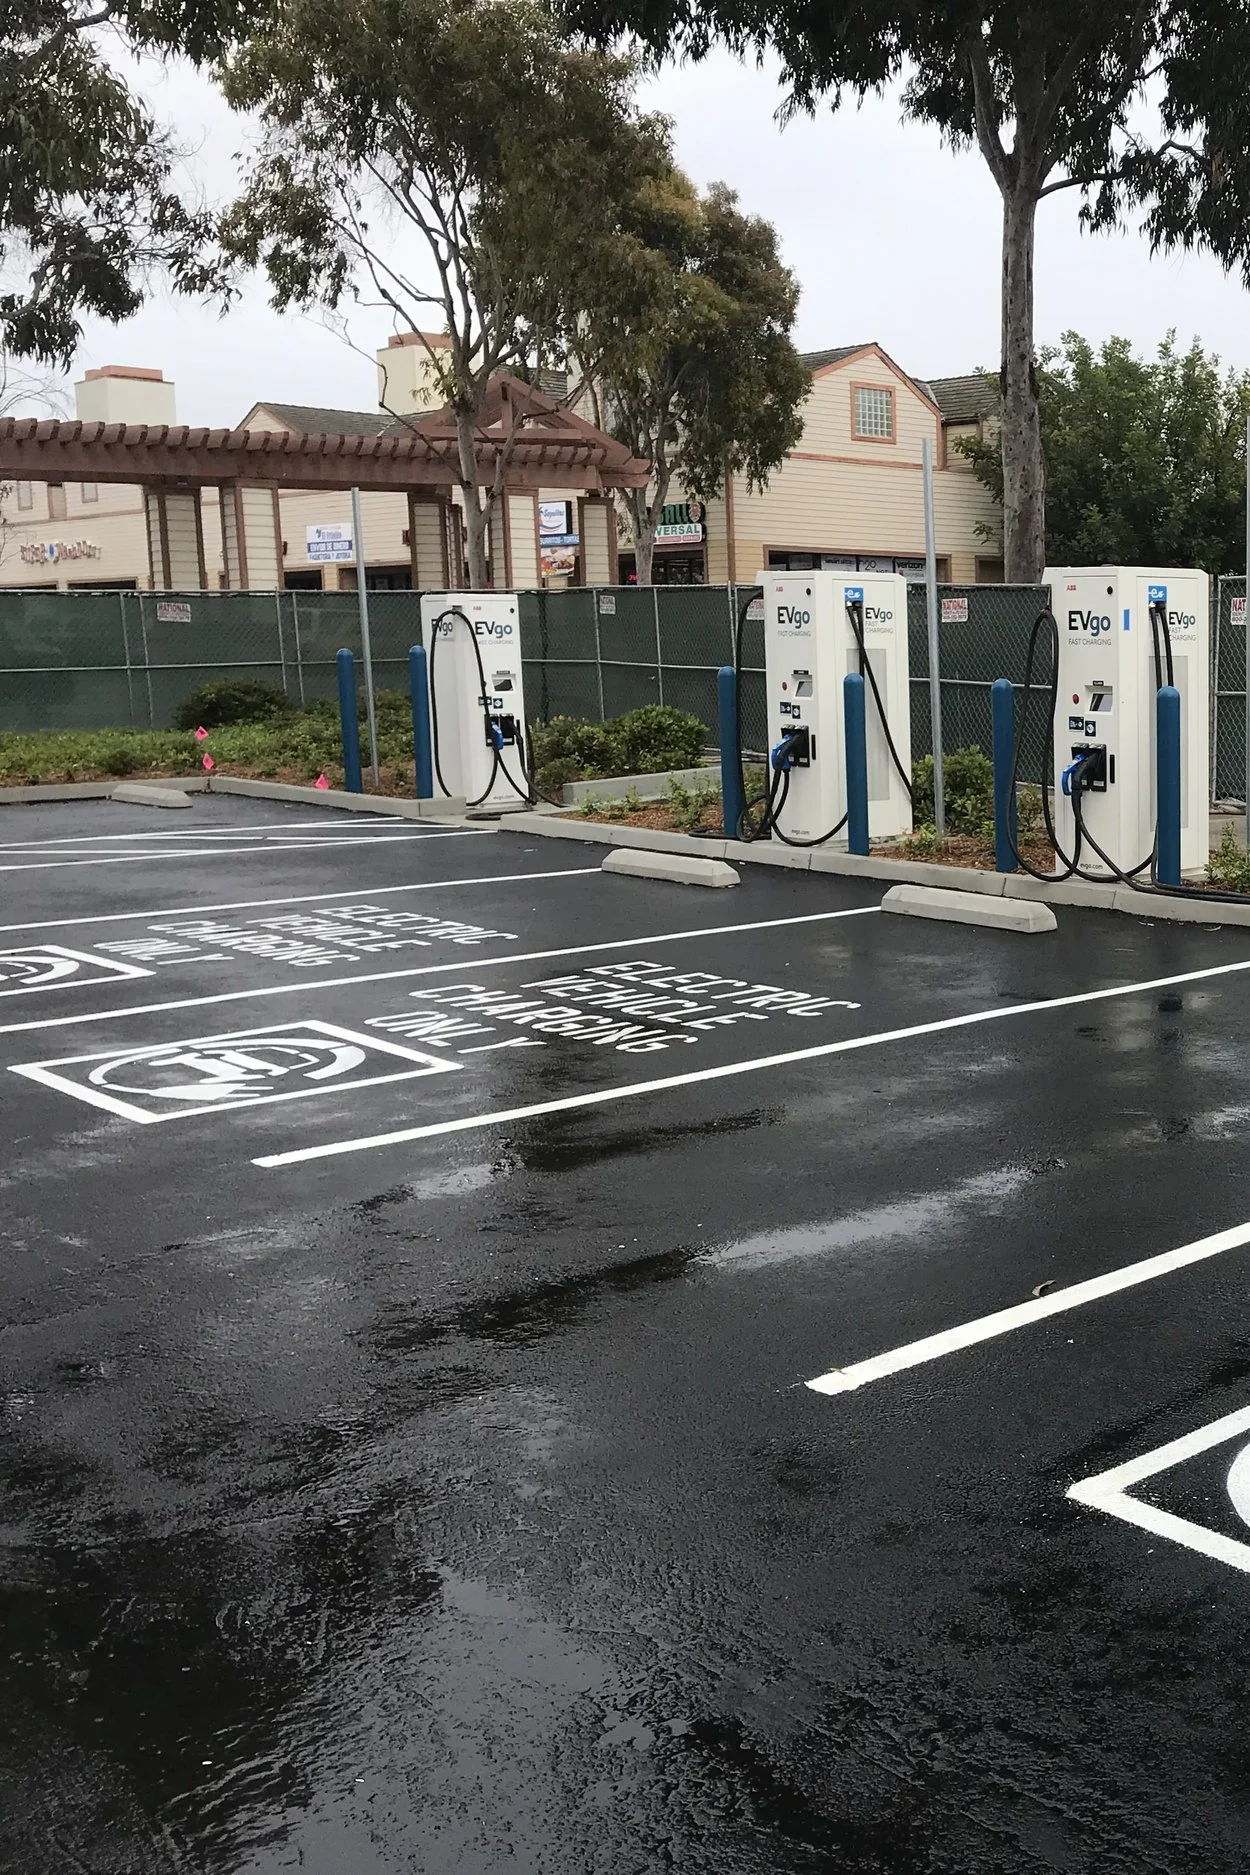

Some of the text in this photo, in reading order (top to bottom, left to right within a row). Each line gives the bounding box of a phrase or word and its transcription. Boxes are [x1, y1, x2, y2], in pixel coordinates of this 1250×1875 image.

[897, 560, 924, 569] verizon
[777, 606, 810, 629] EVgo
[865, 607, 893, 623] EVgo
[1068, 610, 1111, 637] EVgo
[1169, 612, 1196, 629] EVgo
[475, 621, 513, 639] EVgo
[1082, 638, 1112, 646] CHARGING
[246, 914, 432, 953] VEHICLE
[312, 904, 518, 945] ELECTRIC
[93, 938, 235, 965] ONLY
[147, 920, 360, 967] CHARGING
[585, 960, 862, 1017] ELECTRIC
[520, 975, 770, 1031] VEHICLE
[409, 984, 699, 1053] CHARGING
[364, 1011, 547, 1054] ONLY
